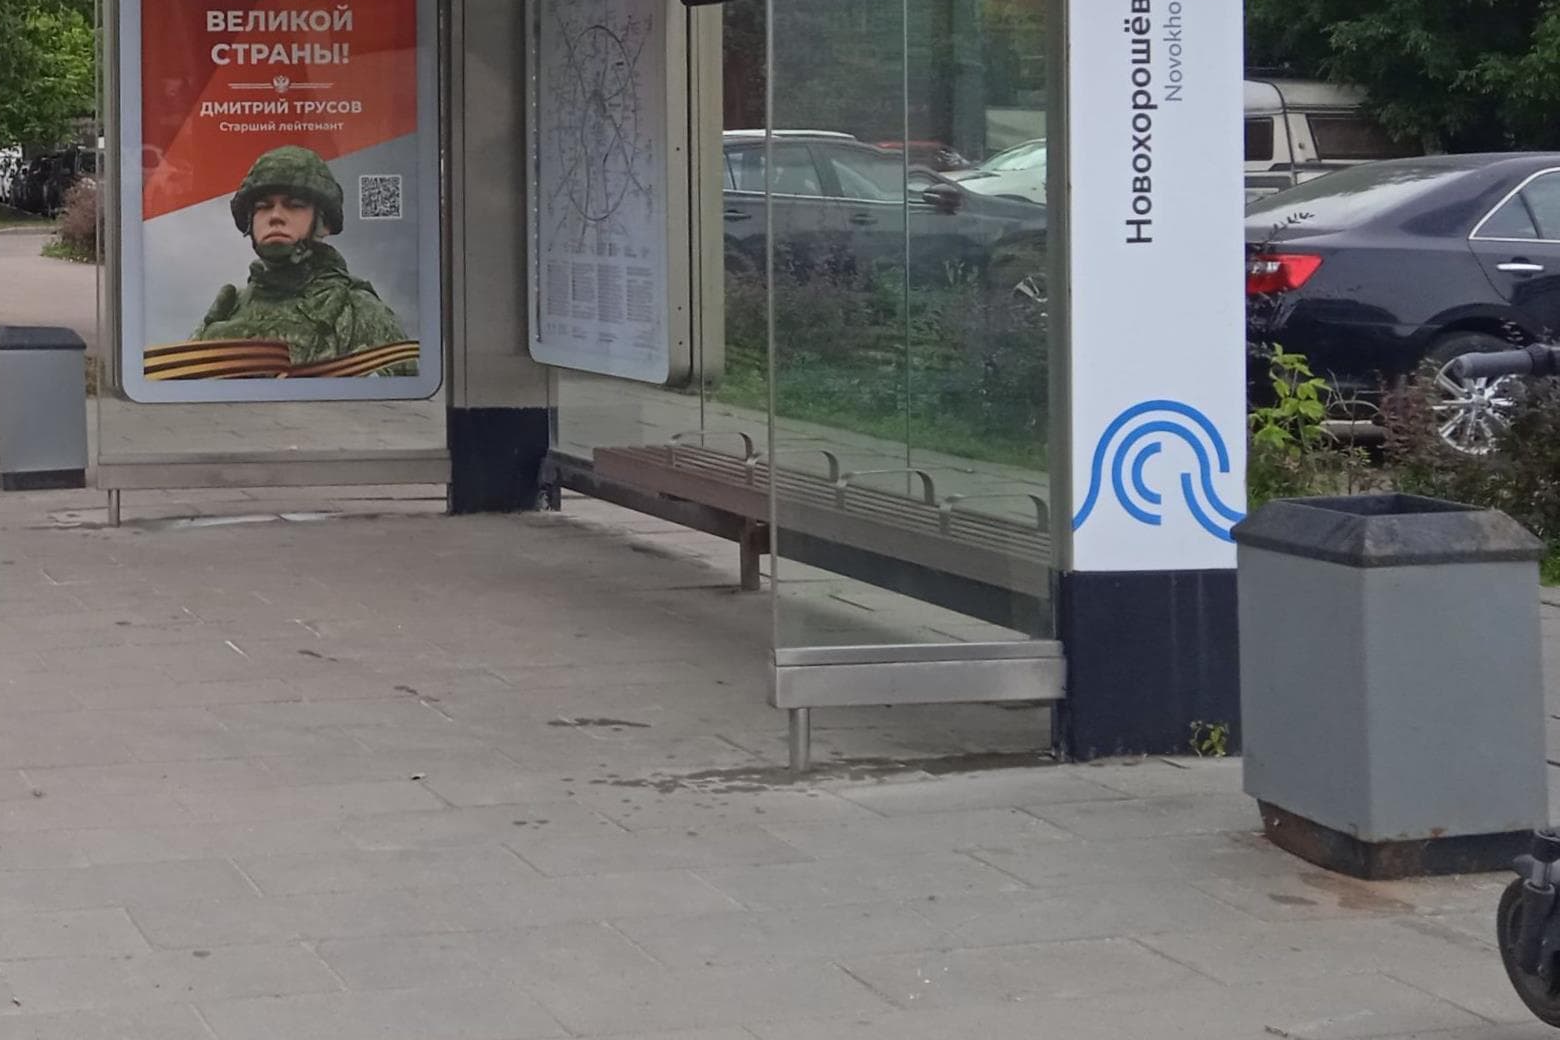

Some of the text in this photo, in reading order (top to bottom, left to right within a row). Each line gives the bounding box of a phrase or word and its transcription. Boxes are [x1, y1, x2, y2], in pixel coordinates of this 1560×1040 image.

[206, 4, 353, 32] ВЕЛИКОЙ
[211, 43, 350, 65] СТРАНЫ!
[200, 98, 363, 117] ДМИТРИЙ ТРУСОВ
[220, 121, 343, 134] Старший лейтенант
